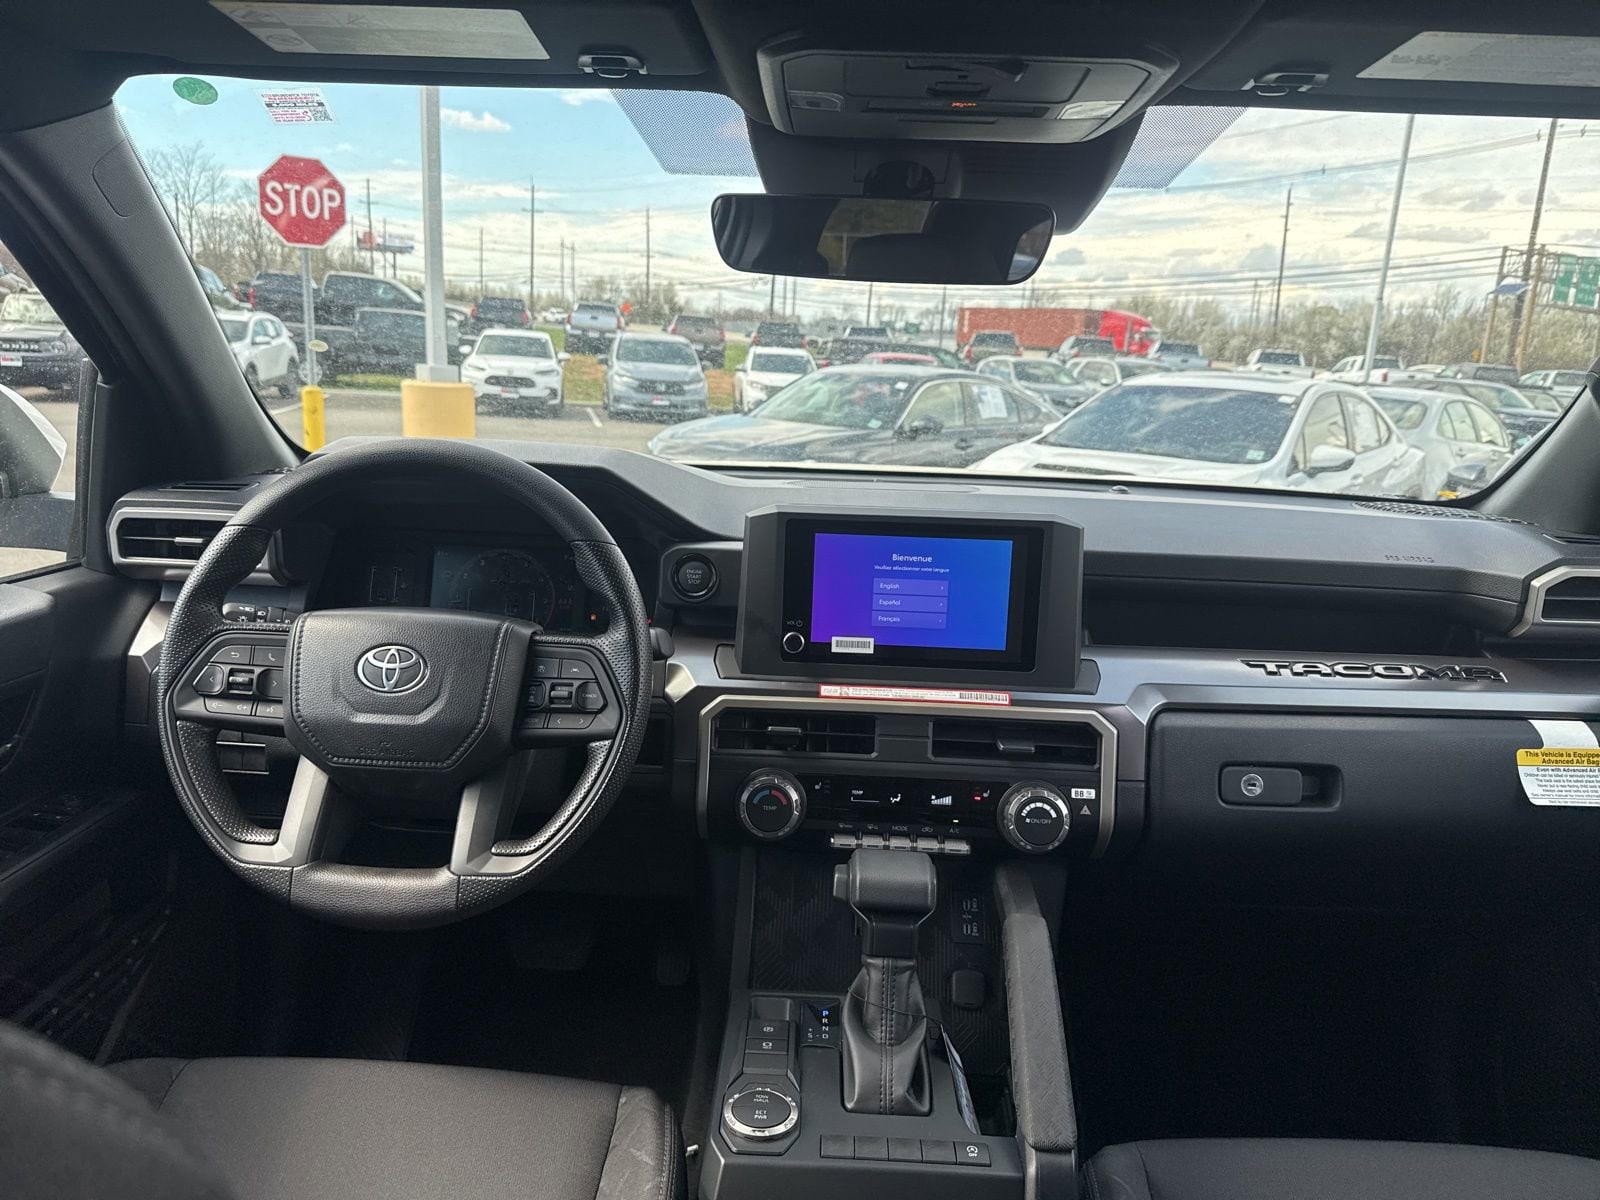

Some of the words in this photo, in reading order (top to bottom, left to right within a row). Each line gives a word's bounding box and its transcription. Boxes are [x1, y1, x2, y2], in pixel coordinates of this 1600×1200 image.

[264, 180, 340, 220] STOP
[892, 553, 932, 562] Bienvenue
[1238, 658, 1508, 683] TACOMA
[1573, 752, 1600, 760] Equippe
